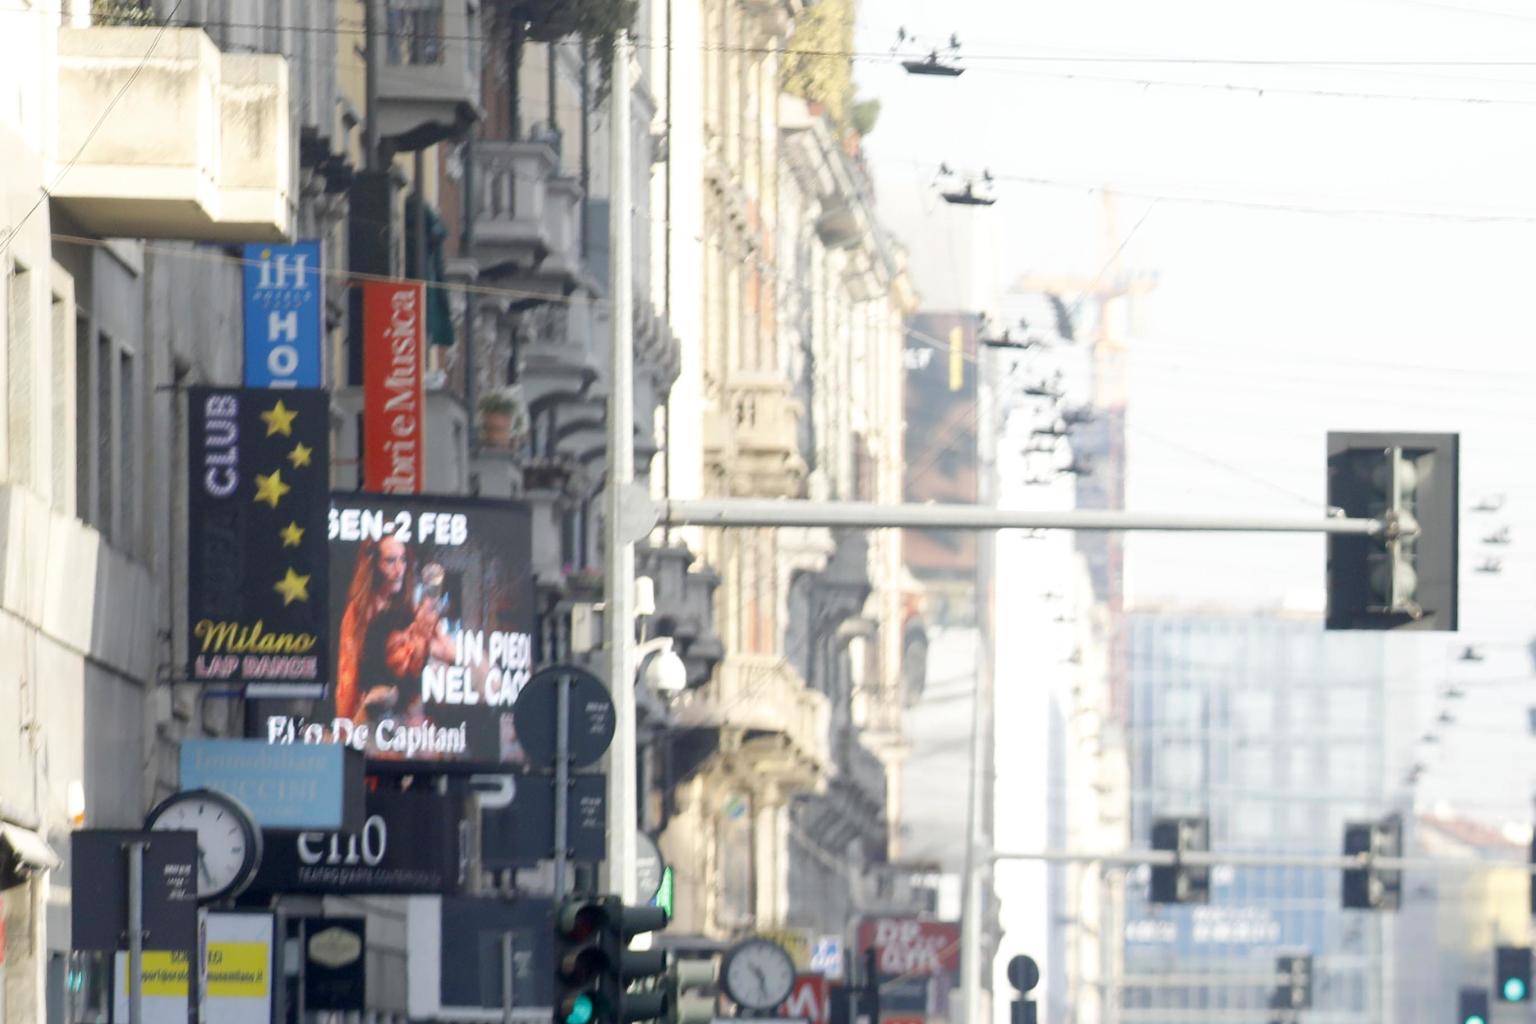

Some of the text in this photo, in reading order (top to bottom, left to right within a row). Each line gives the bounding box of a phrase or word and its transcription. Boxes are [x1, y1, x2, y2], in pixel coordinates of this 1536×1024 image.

[382, 288, 417, 413] Musica
[390, 413, 417, 437] e
[205, 393, 239, 498] CLUB
[418, 512, 468, 545] FEB
[194, 617, 318, 654] Milano
[455, 629, 485, 667] IN
[194, 655, 318, 680] LAP DANCE
[421, 664, 480, 704] NEL
[332, 716, 369, 751] De
[374, 718, 467, 759] Capitani
